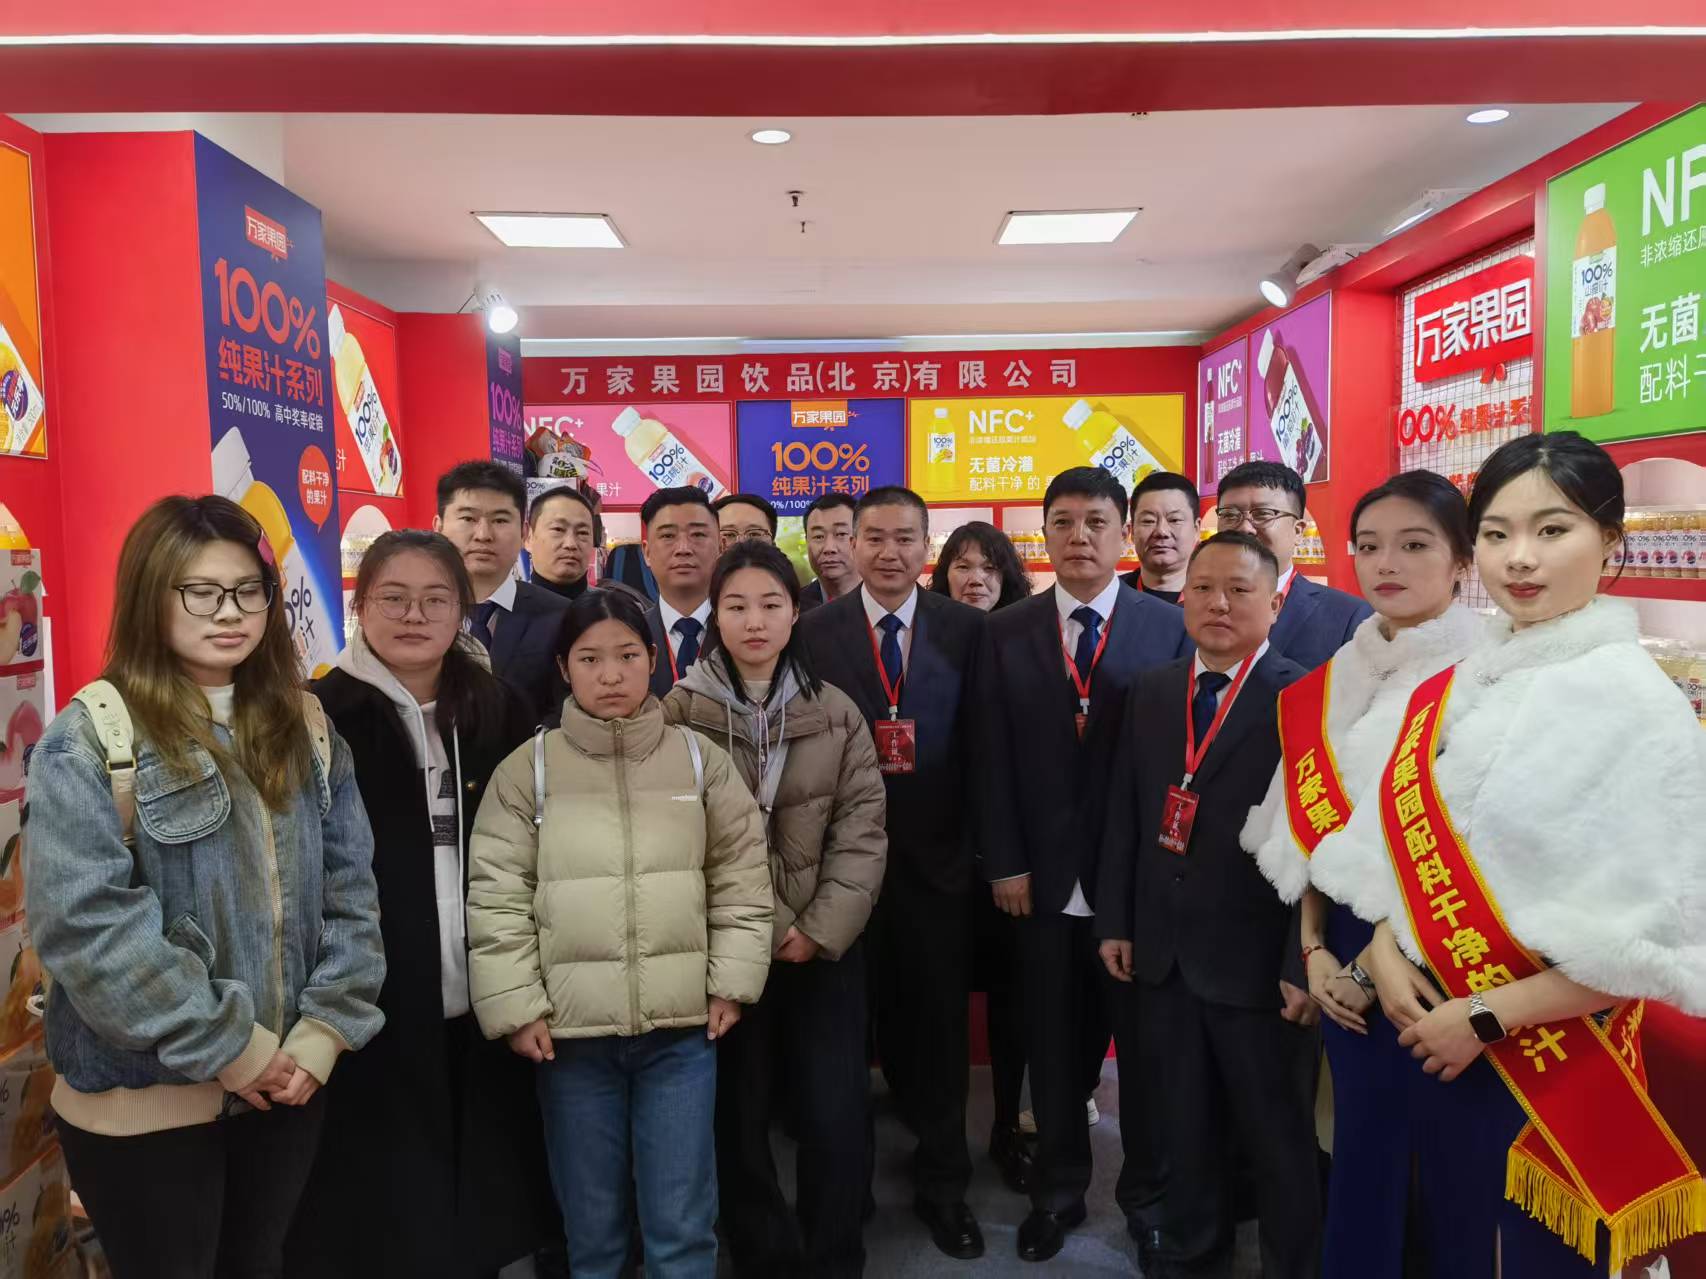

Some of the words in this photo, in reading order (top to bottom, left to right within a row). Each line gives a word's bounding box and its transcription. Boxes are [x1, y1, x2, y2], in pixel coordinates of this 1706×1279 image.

[245, 214, 288, 253] 万家果园
[1581, 262, 1613, 285] 100%
[214, 257, 321, 360] 100%
[1415, 277, 1531, 368] 万家果园
[218, 336, 324, 406] 纯果汁系列
[560, 358, 1077, 395] 万家果园饮品(北京)有限公司
[221, 391, 270, 419] 50%/100%
[355, 385, 378, 446] 100%
[490, 382, 522, 432] 100%
[793, 410, 846, 425] 万家果园
[1276, 382, 1299, 444] 100%
[648, 443, 684, 481] 100%
[772, 441, 871, 472] 100%
[968, 456, 1034, 474] 无菌冷灌
[1099, 435, 1135, 469] 00%
[772, 475, 870, 496] 纯果汁系列
[968, 476, 1023, 491] 配料干净
[1027, 475, 1040, 490] 的
[1295, 748, 1345, 834] 万家果
[1391, 701, 1568, 1073] 万家果园配料干净的汁
